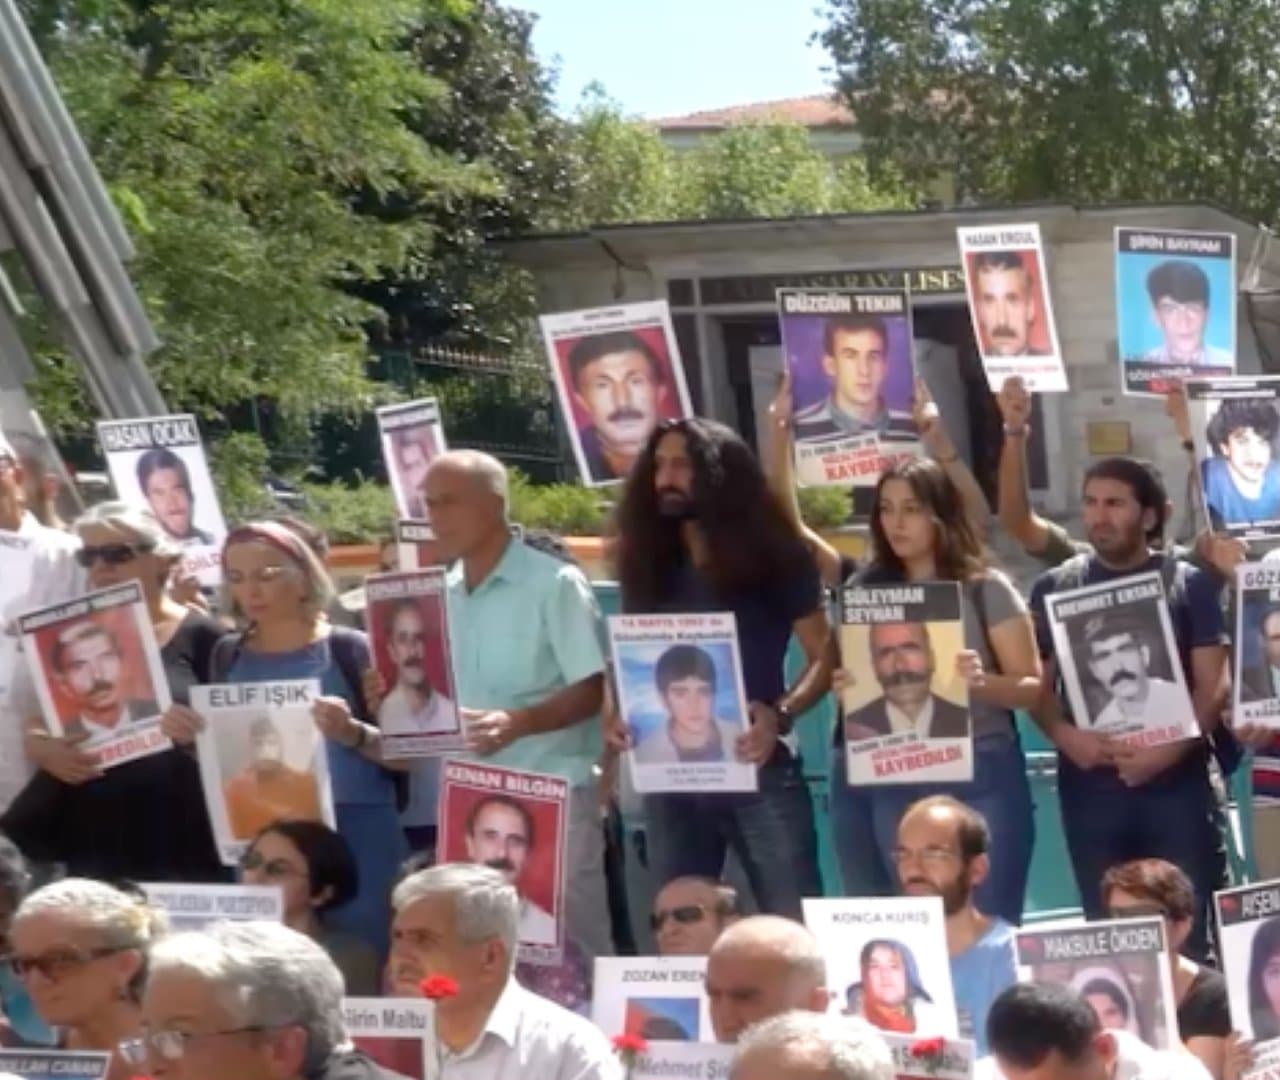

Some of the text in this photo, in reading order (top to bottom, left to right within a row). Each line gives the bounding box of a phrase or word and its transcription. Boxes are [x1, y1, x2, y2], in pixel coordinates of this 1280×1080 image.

[447, 766, 502, 788] KENAN
[831, 911, 883, 925] KONCA
[1043, 925, 1162, 960] MAKBULE ÖKDEM
[622, 969, 669, 983] ZOZAN
